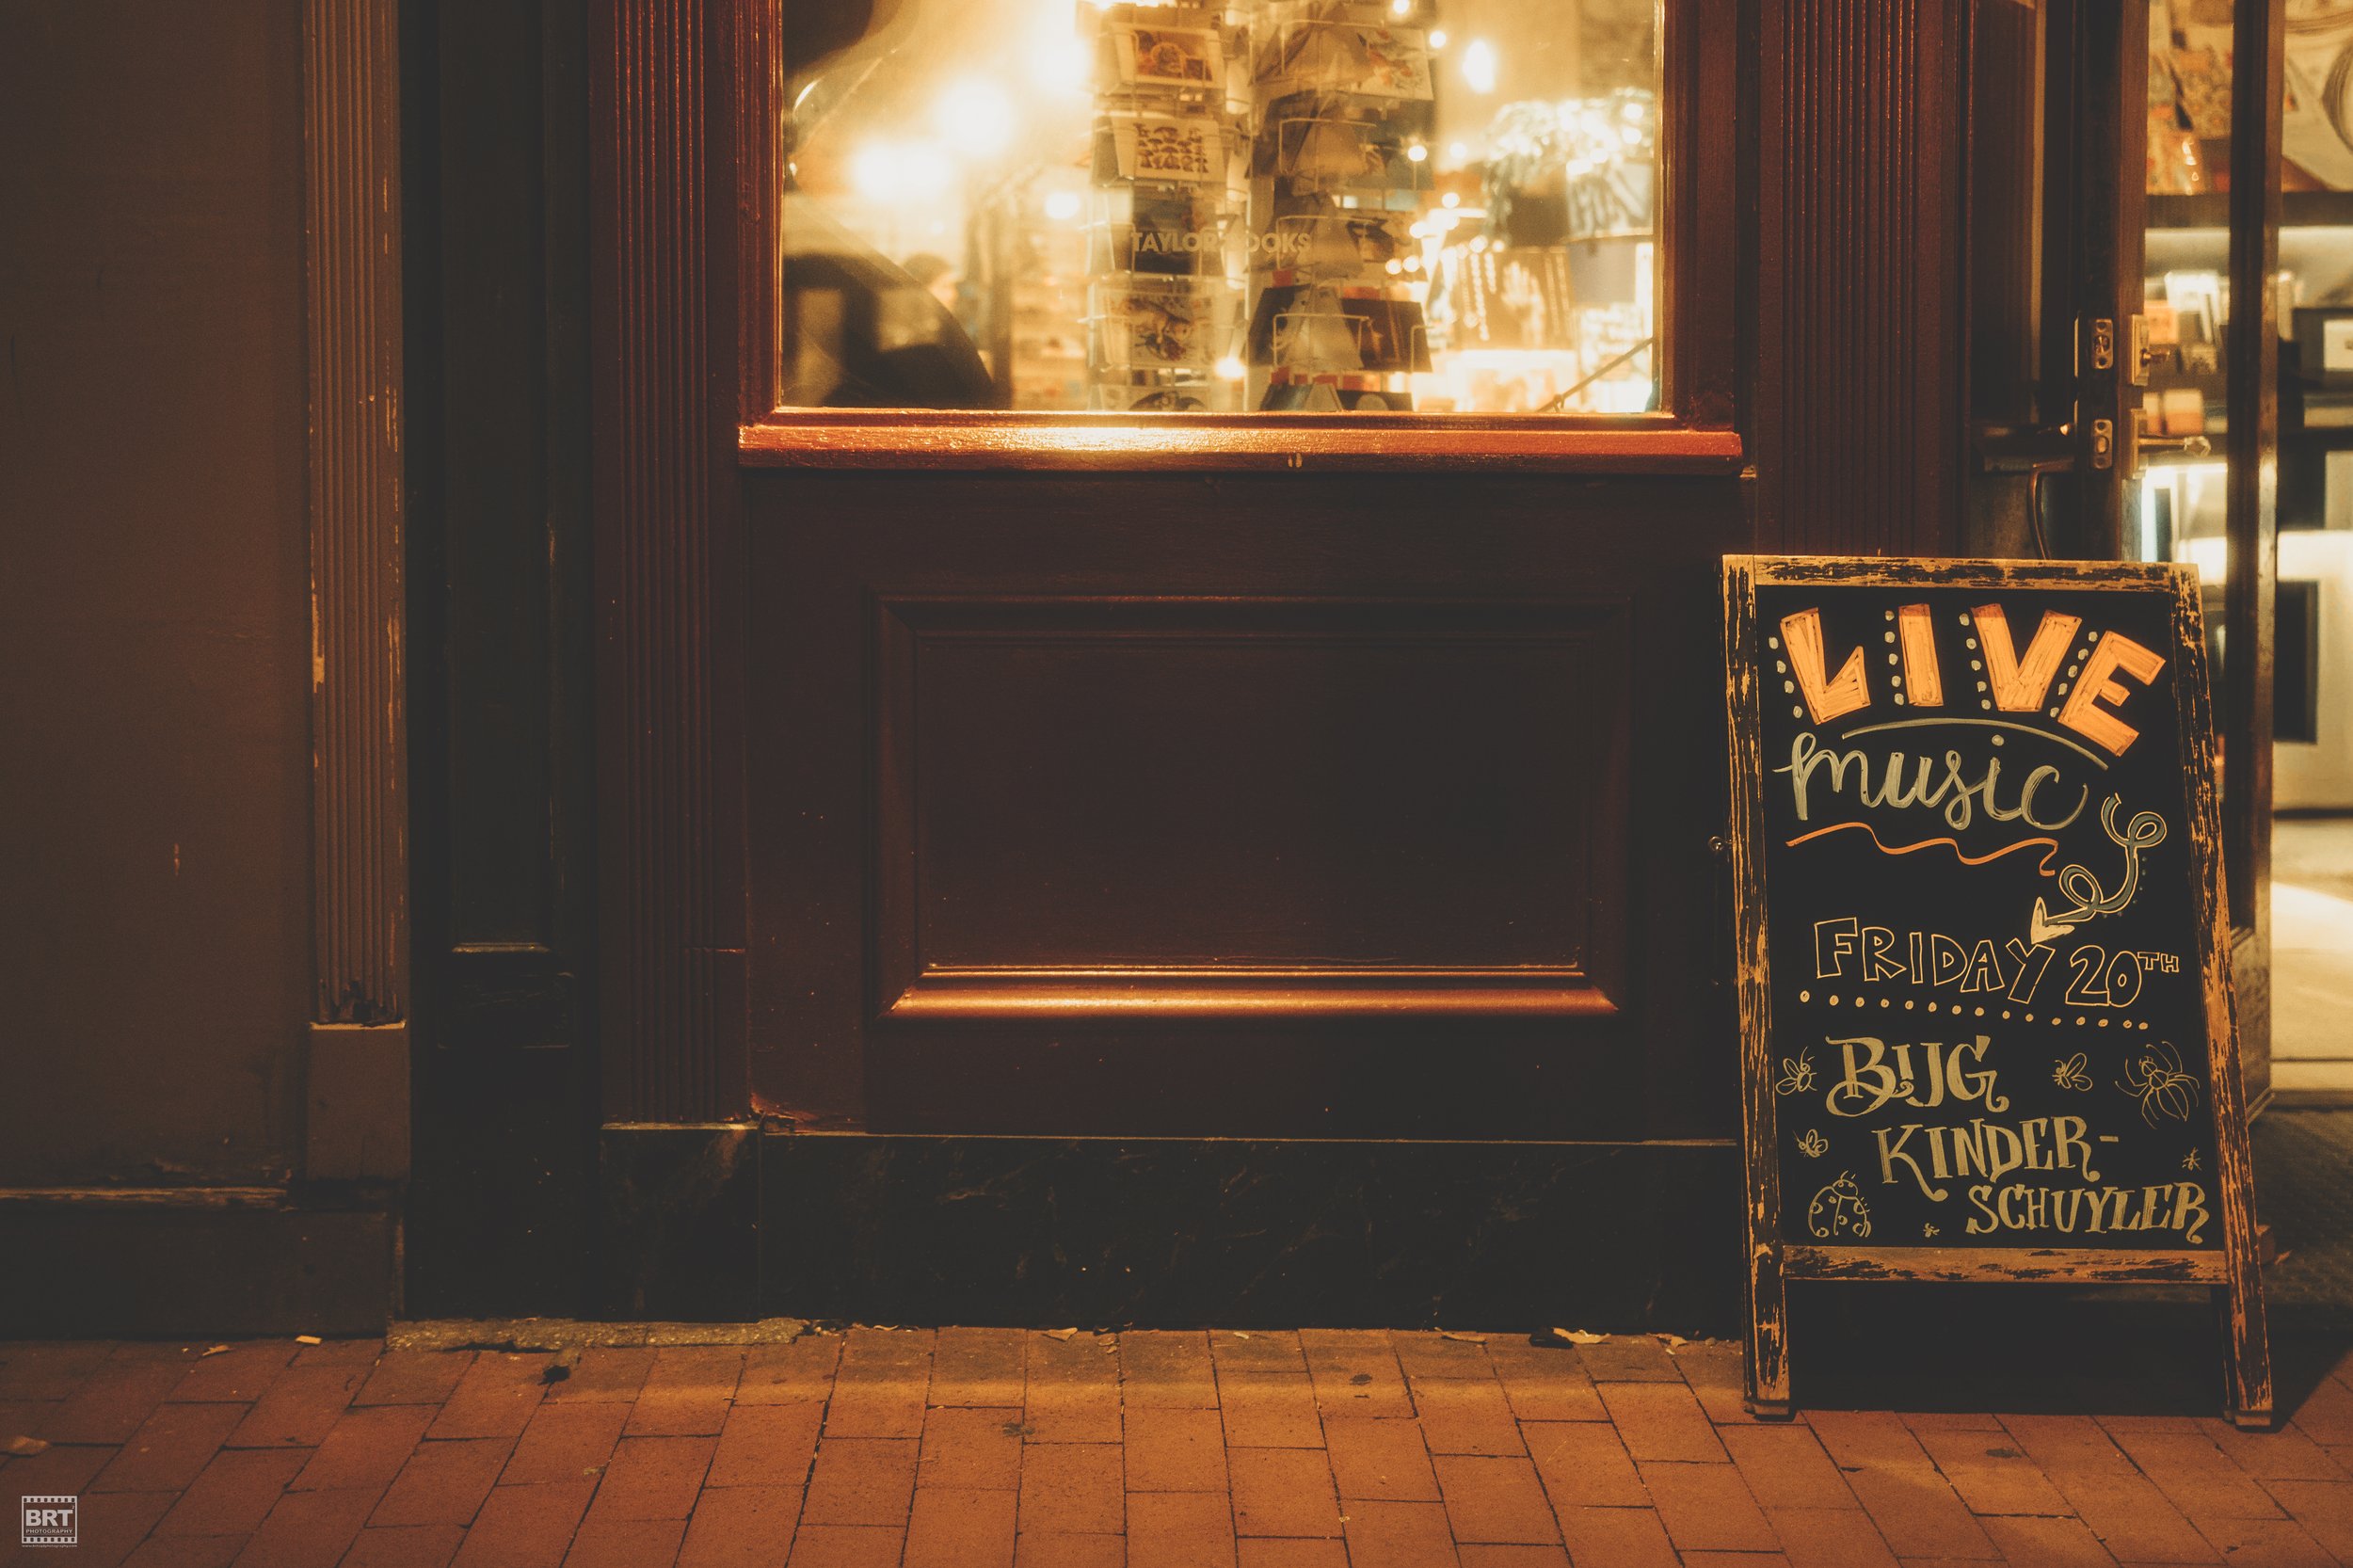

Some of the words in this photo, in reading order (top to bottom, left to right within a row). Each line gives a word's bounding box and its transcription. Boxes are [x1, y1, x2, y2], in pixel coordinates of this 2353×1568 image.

[1130, 232, 1218, 253] TAYLOR
[1227, 232, 1312, 253] OOKS
[1780, 603, 2166, 757] LIVE
[1774, 732, 2089, 830] music
[1814, 917, 2056, 1004] FRIDAY
[2065, 945, 2179, 1008] 20TH
[1825, 1035, 2009, 1117] BUG
[1871, 1116, 2119, 1202] KINDER-
[1965, 1182, 2209, 1244] SCHUYLER
